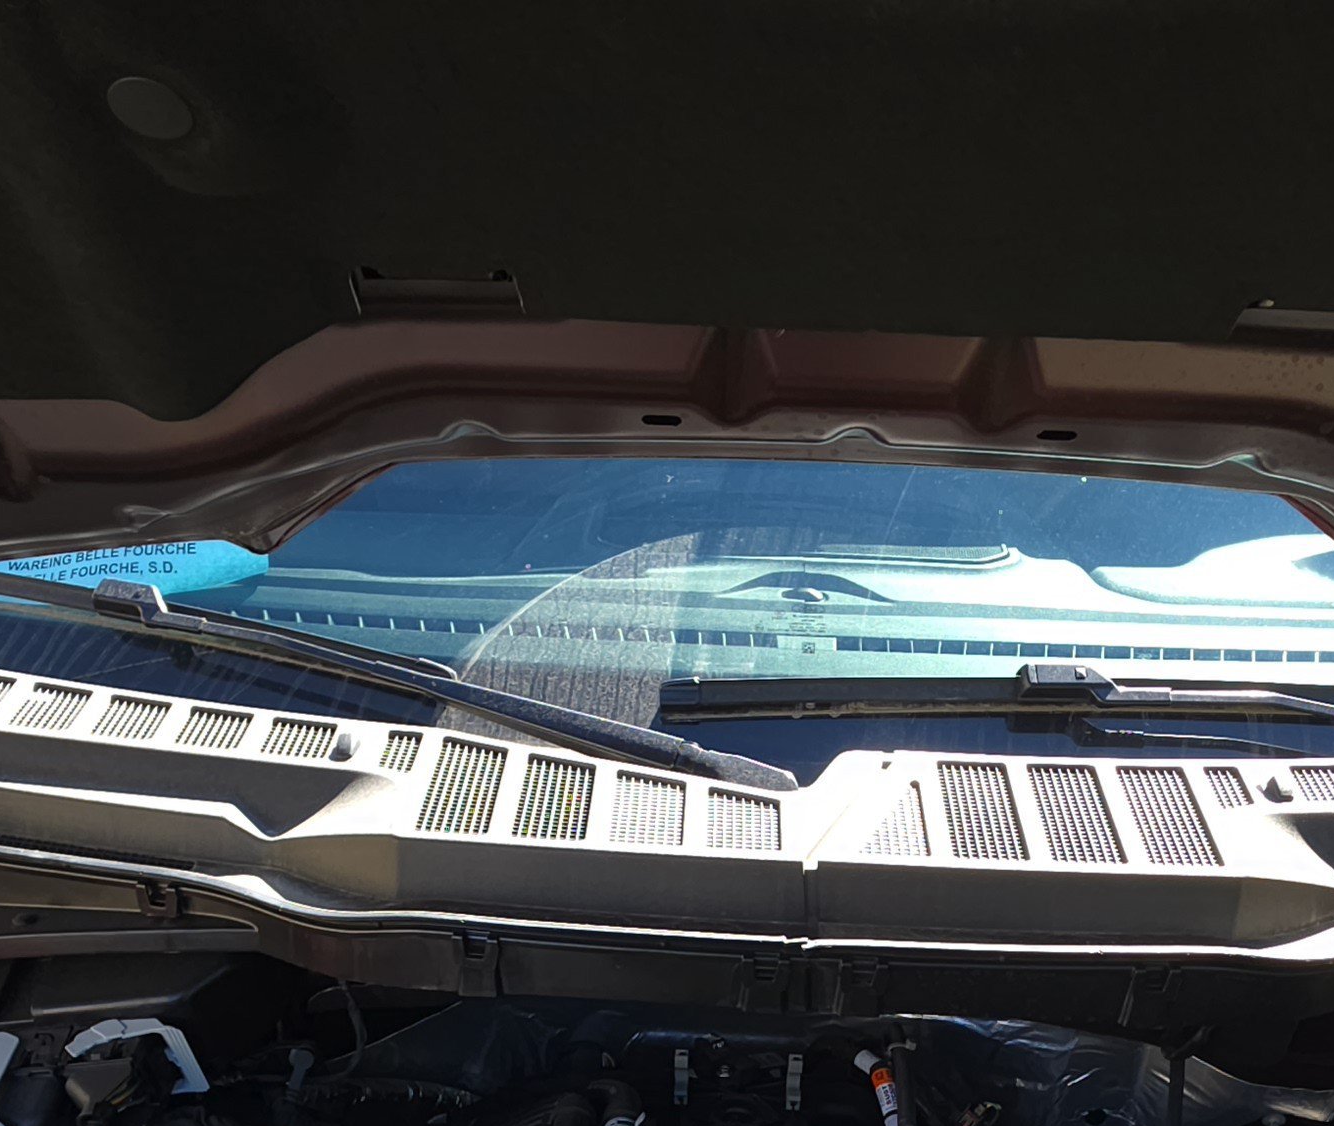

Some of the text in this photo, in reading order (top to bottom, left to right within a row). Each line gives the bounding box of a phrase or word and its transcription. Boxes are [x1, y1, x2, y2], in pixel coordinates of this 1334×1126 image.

[8, 542, 197, 571] WAREING BELLE FOURCHE
[25, 561, 178, 582] ELLE FOURCHE, S.D.
